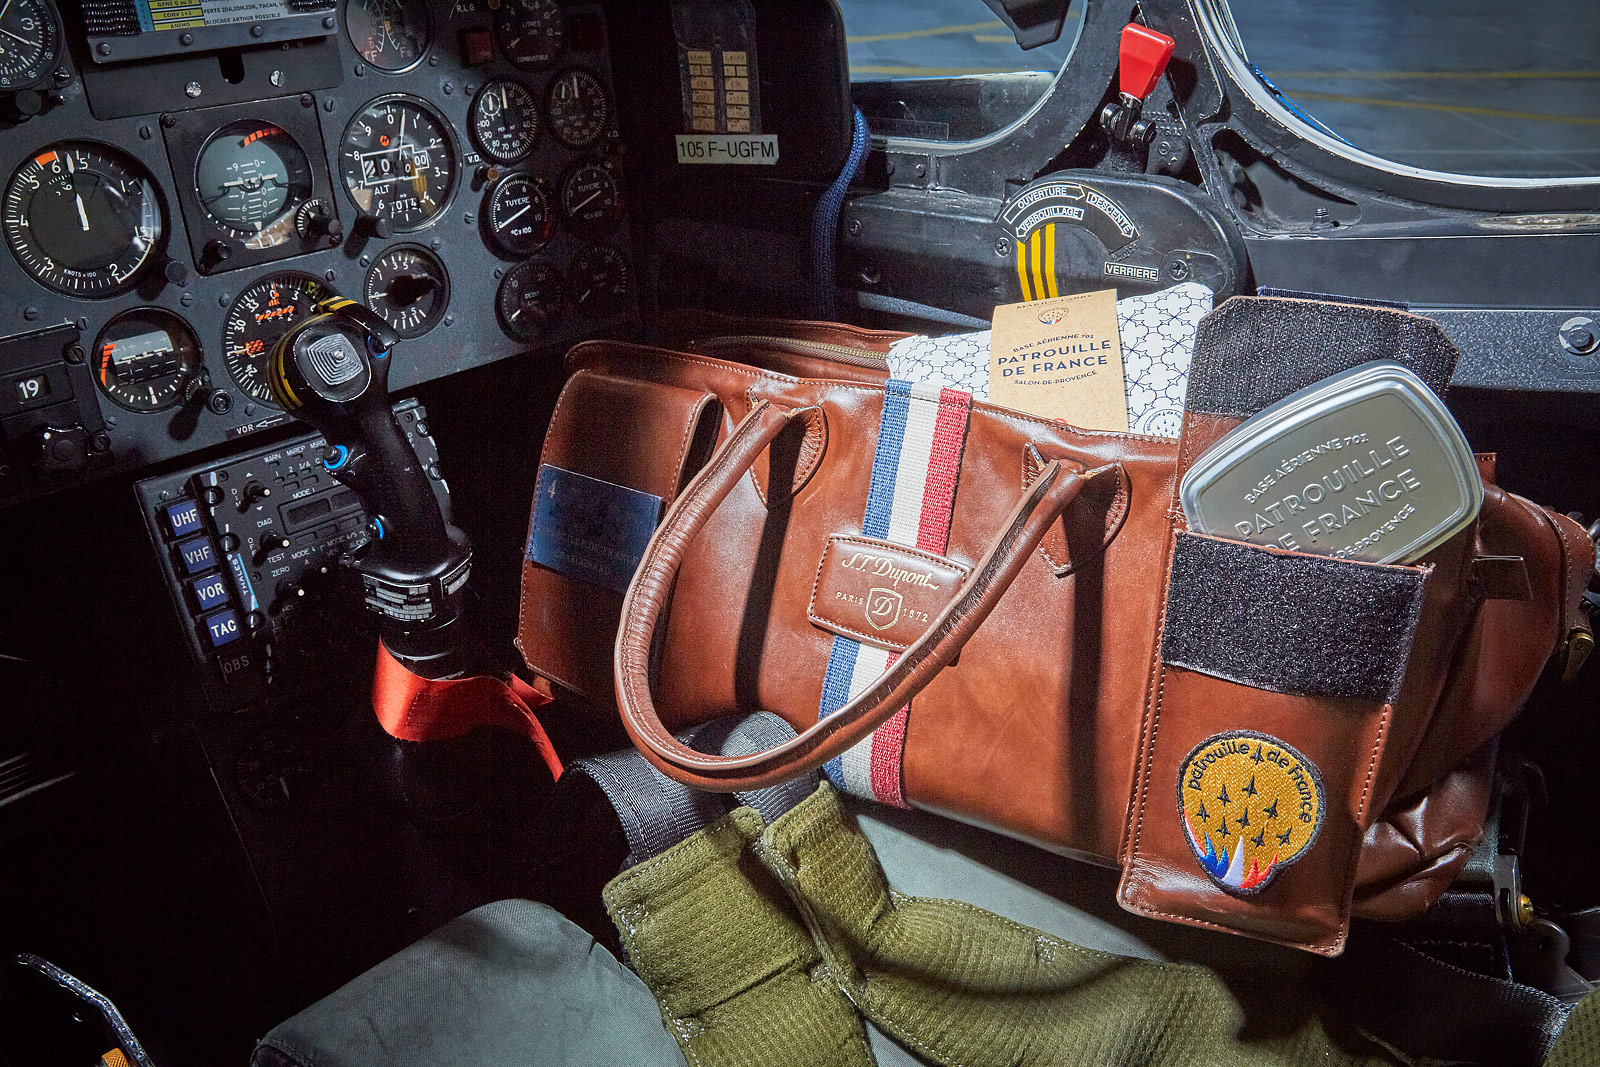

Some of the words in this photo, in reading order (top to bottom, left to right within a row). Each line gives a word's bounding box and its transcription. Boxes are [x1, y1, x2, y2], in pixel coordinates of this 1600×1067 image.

[20, 17, 35, 31] 3
[206, 17, 231, 25] BLOCAGE
[255, 12, 282, 20] POSSIBLE
[387, 113, 395, 125] 0
[365, 126, 372, 137] 9
[429, 138, 437, 149] 2
[679, 141, 705, 158] 105
[708, 140, 775, 158] F-UGFM
[353, 150, 360, 161] 8
[51, 159, 61, 174] 6
[434, 166, 441, 177] 3
[29, 174, 40, 190] 5
[522, 184, 527, 193] 6
[578, 181, 601, 193] TUYERE
[374, 184, 390, 196] ALT
[378, 199, 385, 210] 6
[504, 195, 531, 208] TUYERE
[1016, 187, 1067, 210] OUVERTURE
[20, 214, 29, 228] 4
[1020, 207, 1080, 231] VERROUILLAGE
[1090, 195, 1131, 234] DESCENTE
[44, 256, 55, 271] 3
[109, 262, 120, 277] 2
[402, 261, 409, 270] 5
[63, 268, 82, 278] KNOTS
[1106, 264, 1157, 280] VERRIERE
[400, 310, 407, 320] 3
[410, 306, 417, 315] 5
[234, 319, 247, 333] 30
[1012, 342, 1034, 353] BASE
[1036, 333, 1080, 346] AÉRIENNE
[997, 339, 1111, 366] PATROUILLE
[1002, 366, 1026, 378] DE
[1032, 354, 1108, 374] FRANCE
[1013, 369, 1098, 386] SALON-DE-PROVENCE
[18, 379, 40, 400] 19
[236, 423, 254, 435] VOR
[1244, 474, 1277, 504] BASE
[1275, 437, 1343, 480] AÉRIENNE
[292, 488, 311, 499] MODE
[1234, 435, 1411, 542] PATROUILLE
[1301, 468, 1421, 543] FRANCE
[172, 508, 198, 527] UHF
[256, 517, 273, 528] DIAG
[185, 546, 210, 565] VHF
[267, 552, 285, 564] TEST
[291, 548, 310, 560] MODE
[231, 558, 249, 596] THALES
[271, 565, 290, 577] ZERO
[871, 557, 940, 590] Dupont
[197, 582, 225, 601] VOR
[835, 591, 865, 605] PARIS
[211, 619, 237, 638] TAC
[223, 655, 250, 674] OBS
[1187, 740, 1250, 791] patrouille
[1266, 750, 1290, 769] de
